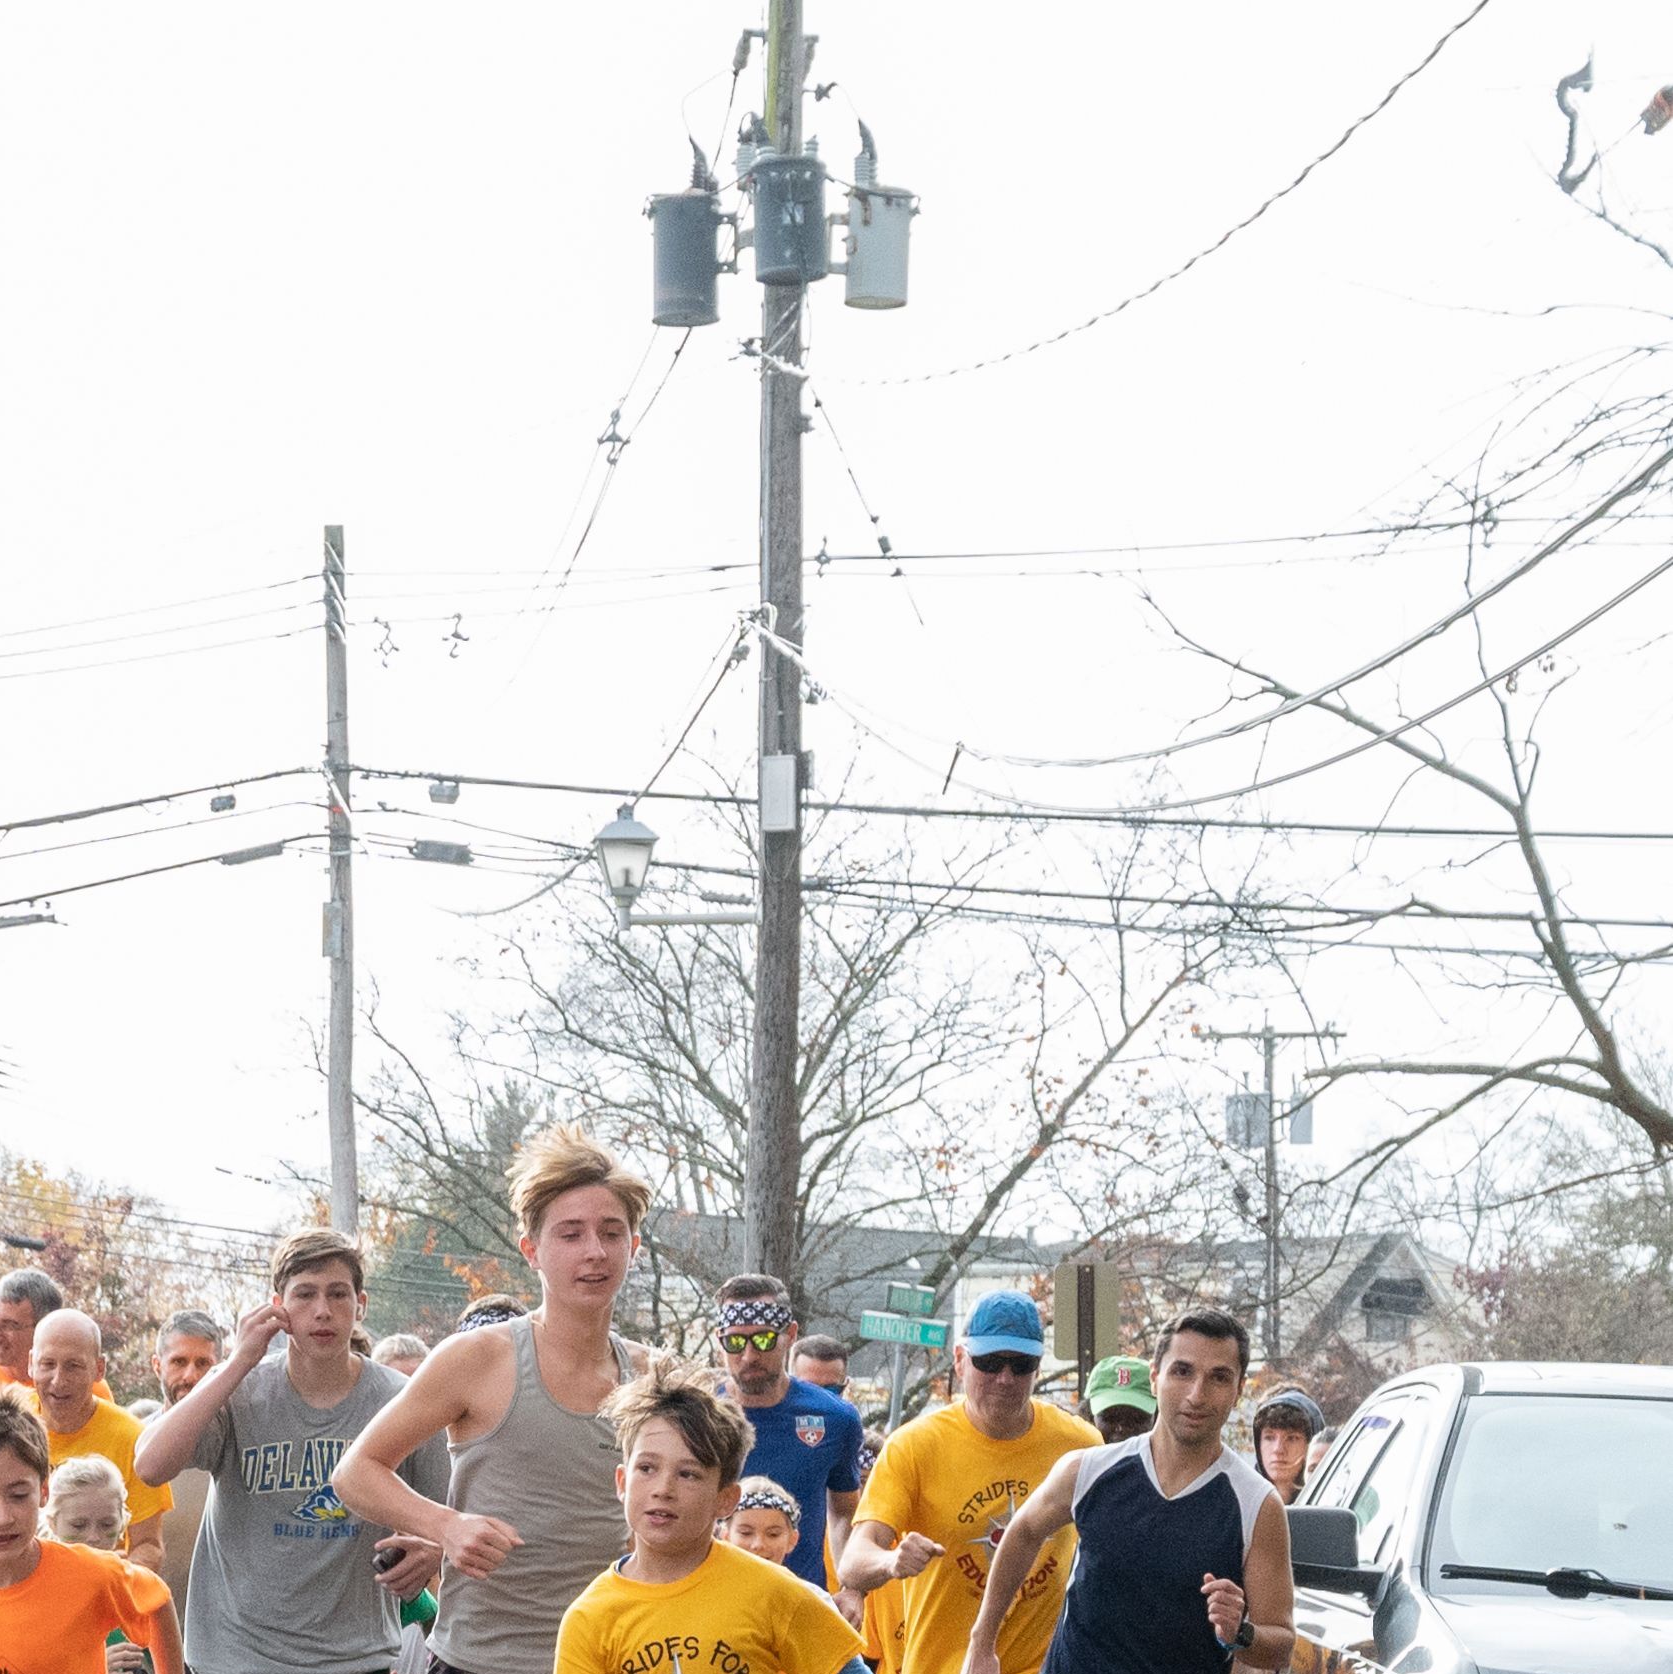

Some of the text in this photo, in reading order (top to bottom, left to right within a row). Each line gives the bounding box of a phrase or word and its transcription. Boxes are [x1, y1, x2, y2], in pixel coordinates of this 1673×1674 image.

[864, 1316, 921, 1341] HANOVER
[241, 1438, 354, 1494] DELAW
[957, 1479, 1029, 1524] STRIDES
[274, 1522, 314, 1537] BLUE
